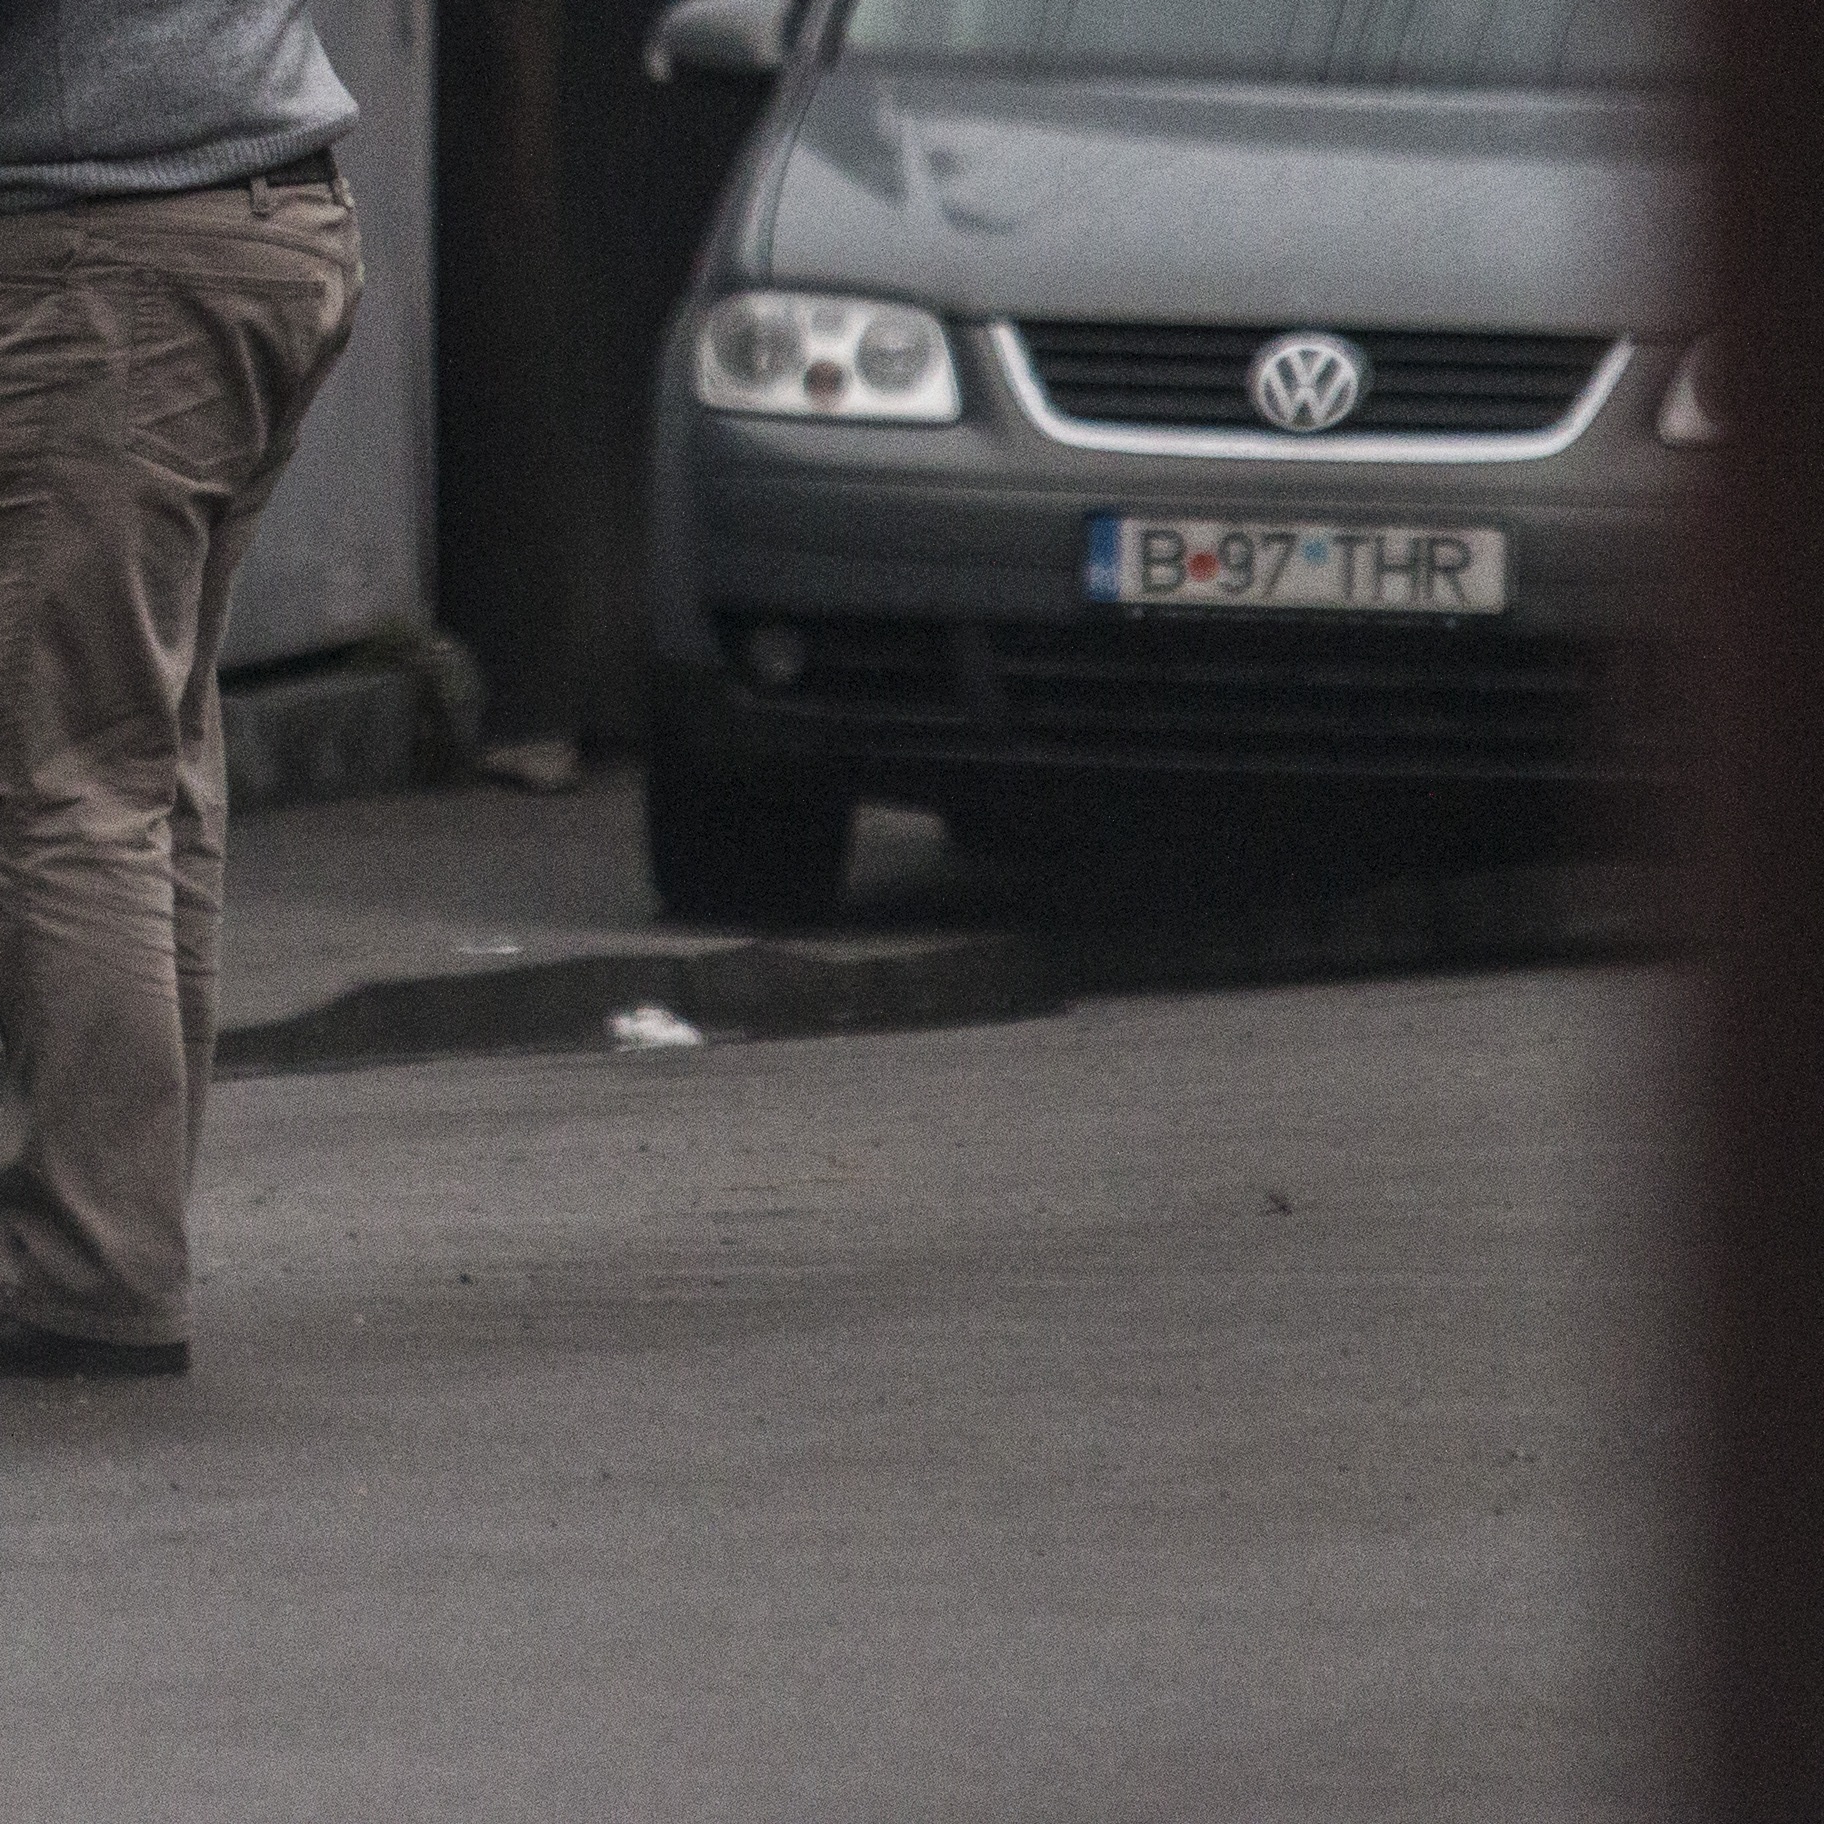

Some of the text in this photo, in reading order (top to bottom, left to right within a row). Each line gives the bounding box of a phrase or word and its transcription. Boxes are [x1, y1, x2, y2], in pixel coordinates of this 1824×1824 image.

[1140, 528, 1474, 606] B 97 THR
